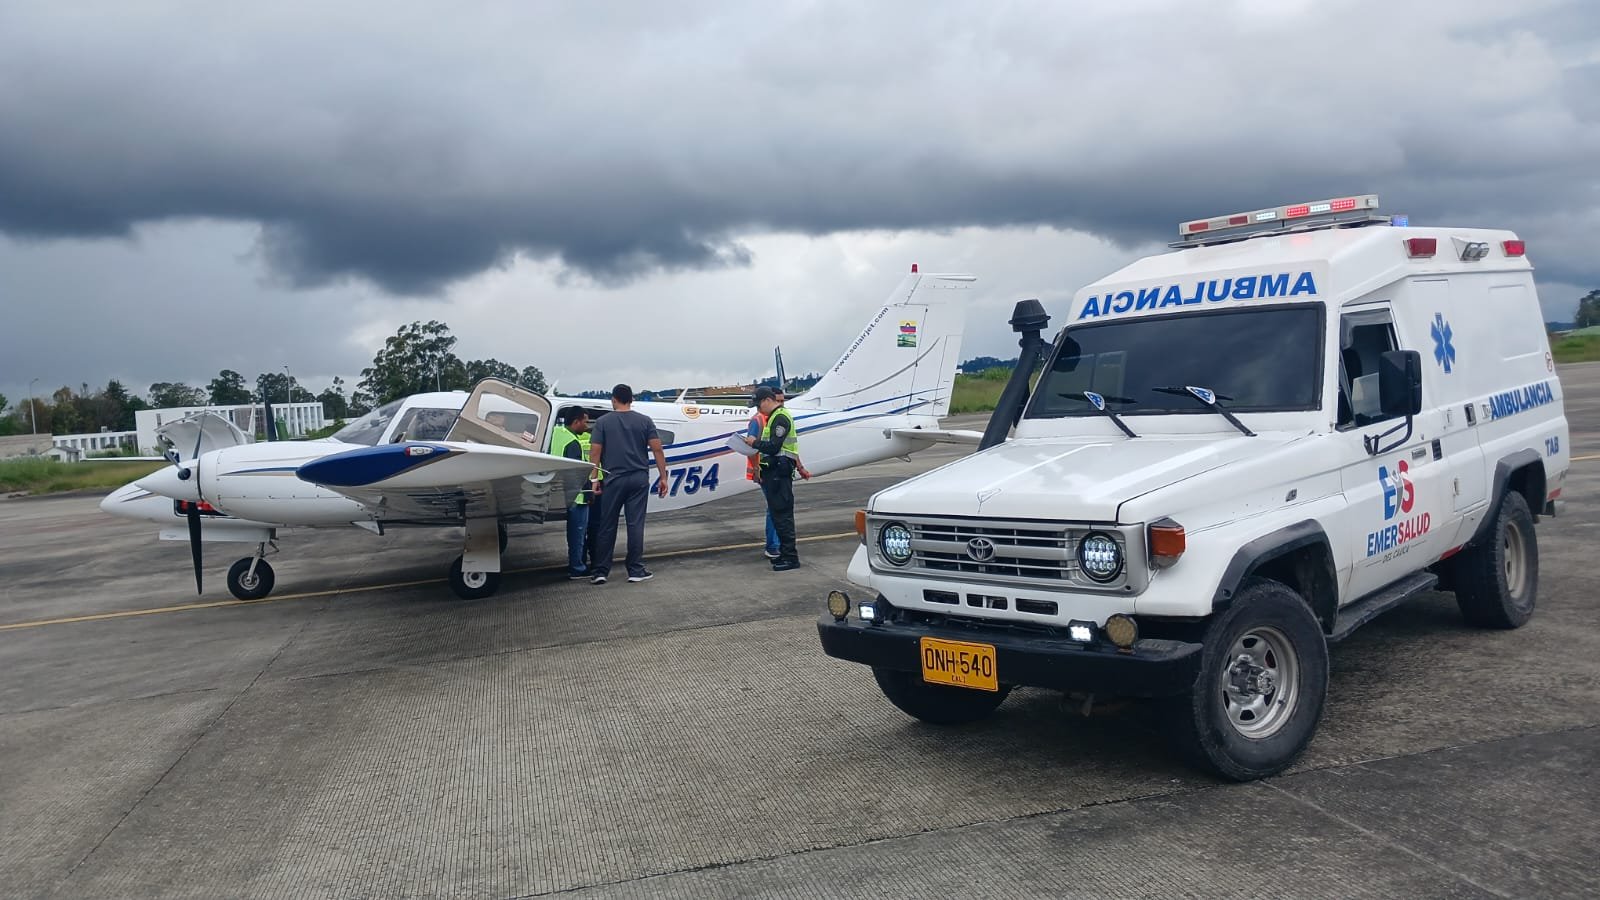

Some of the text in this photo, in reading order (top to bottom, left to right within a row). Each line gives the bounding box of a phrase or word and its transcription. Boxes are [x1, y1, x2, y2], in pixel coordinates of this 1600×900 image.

[833, 307, 889, 373] www.solairjet.com
[685, 406, 750, 416] SOLAIR
[1488, 381, 1554, 421] AMBULANCIA
[1544, 436, 1559, 457] TAB
[1367, 511, 1431, 558] EMERSALUD
